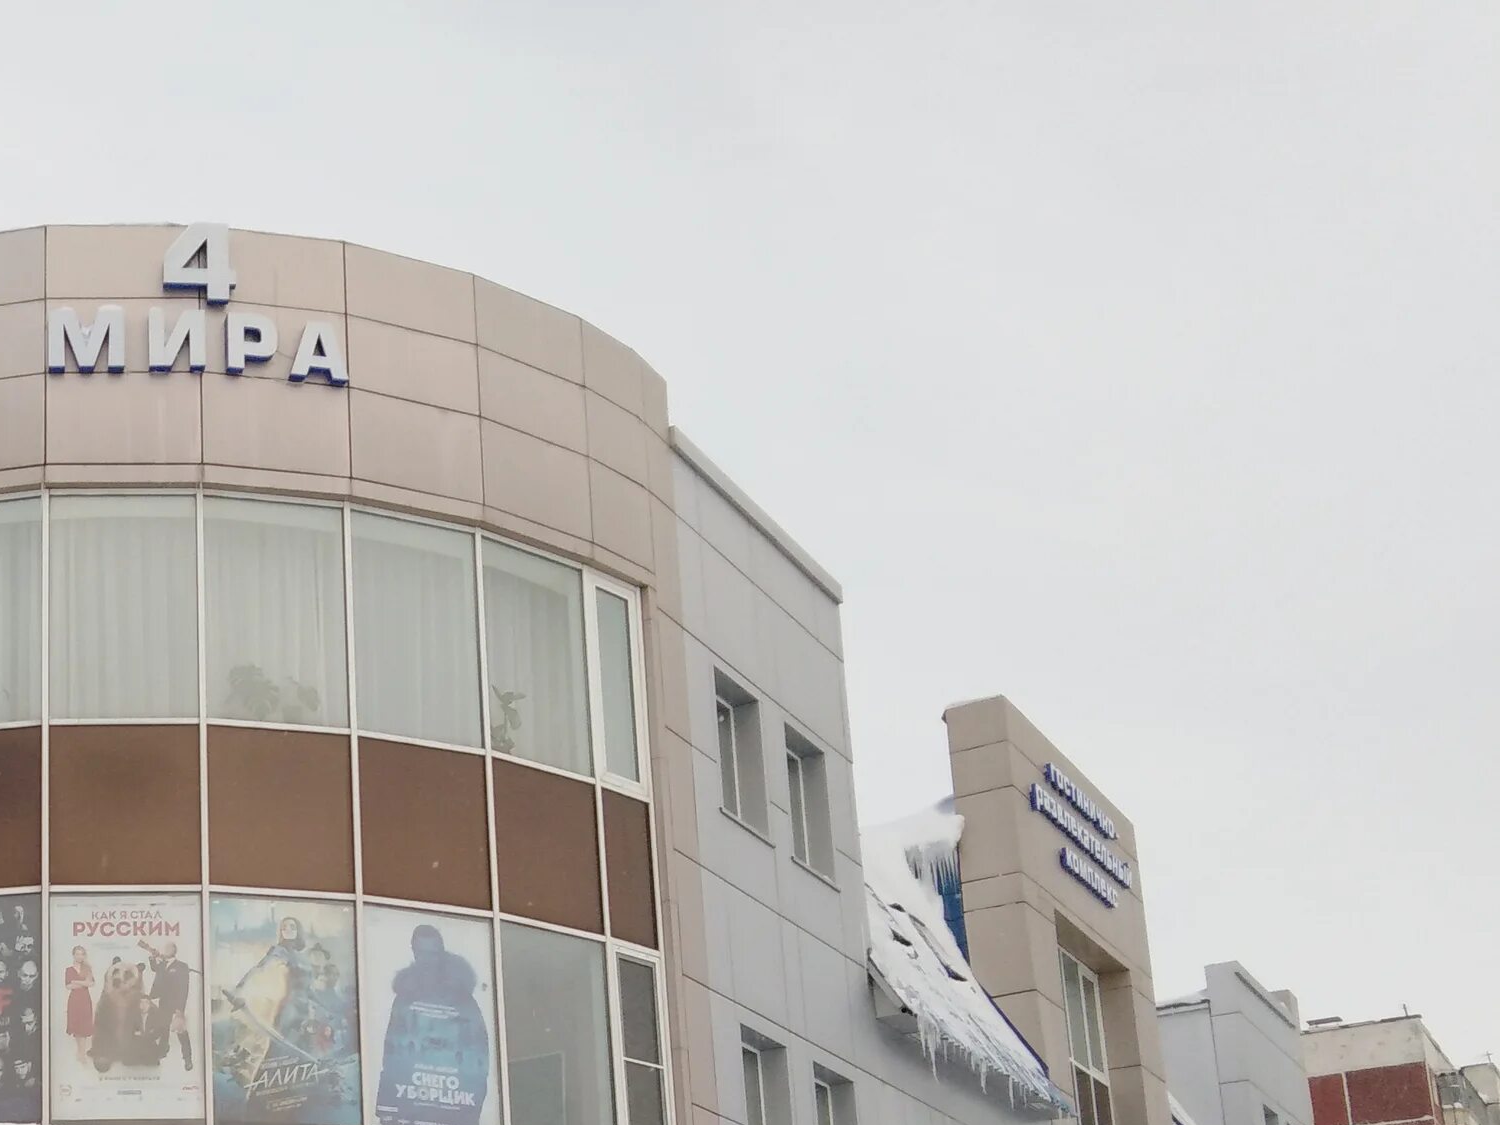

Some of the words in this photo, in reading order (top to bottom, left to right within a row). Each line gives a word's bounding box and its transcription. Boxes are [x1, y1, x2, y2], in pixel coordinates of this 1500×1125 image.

[163, 222, 236, 305] 4
[48, 305, 349, 386] МИРА
[91, 911, 117, 920] КАК
[119, 911, 127, 920] Я
[130, 910, 163, 920] СТАЛ
[72, 921, 181, 937] РУССКИМ
[244, 1063, 330, 1091] АЛИТА
[411, 1071, 460, 1090] СНЕГО
[395, 1083, 476, 1106] УБОРЩИК
